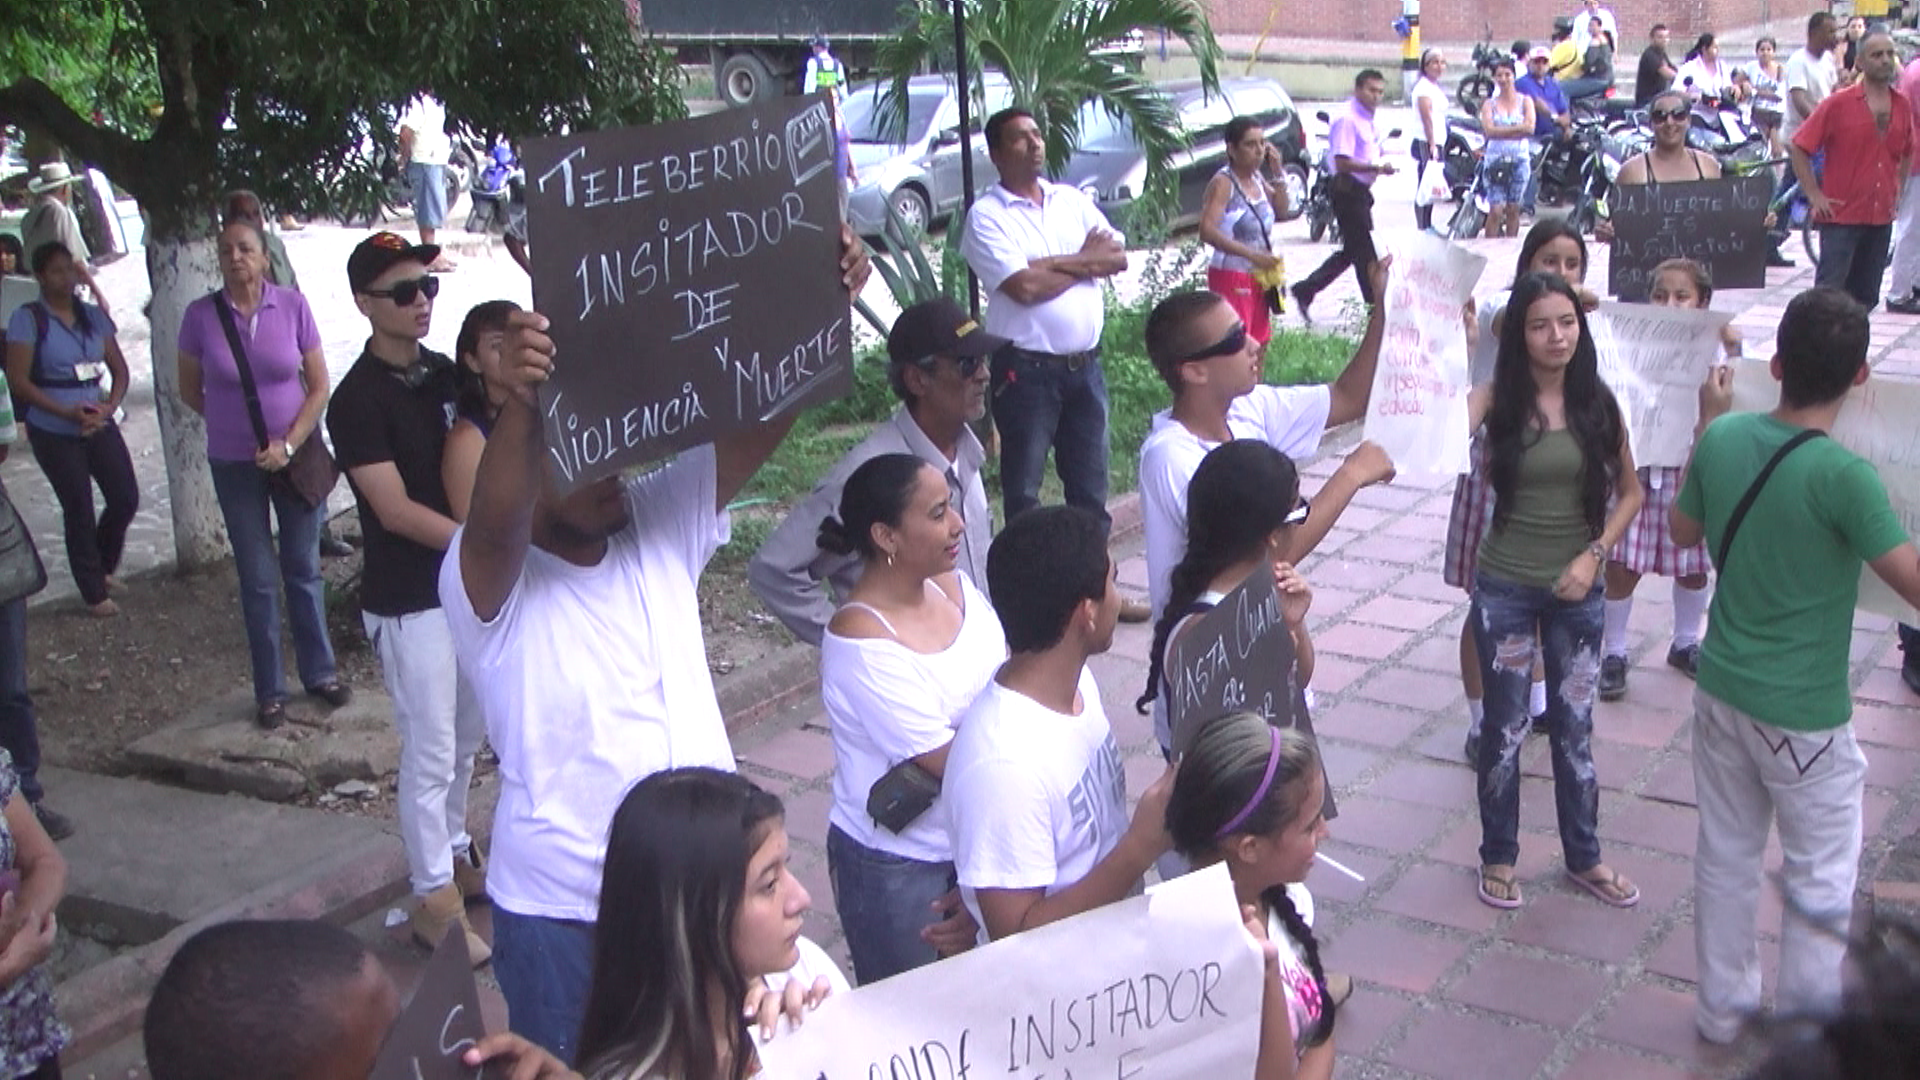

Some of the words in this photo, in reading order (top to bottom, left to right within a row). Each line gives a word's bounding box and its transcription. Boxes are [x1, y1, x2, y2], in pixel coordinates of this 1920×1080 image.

[1642, 183, 1722, 215] MUERTE
[671, 283, 740, 342] DE
[734, 318, 844, 421] MUERTE
[1175, 633, 1231, 720] HASTA
[1007, 961, 1228, 1073] INSITADOR
